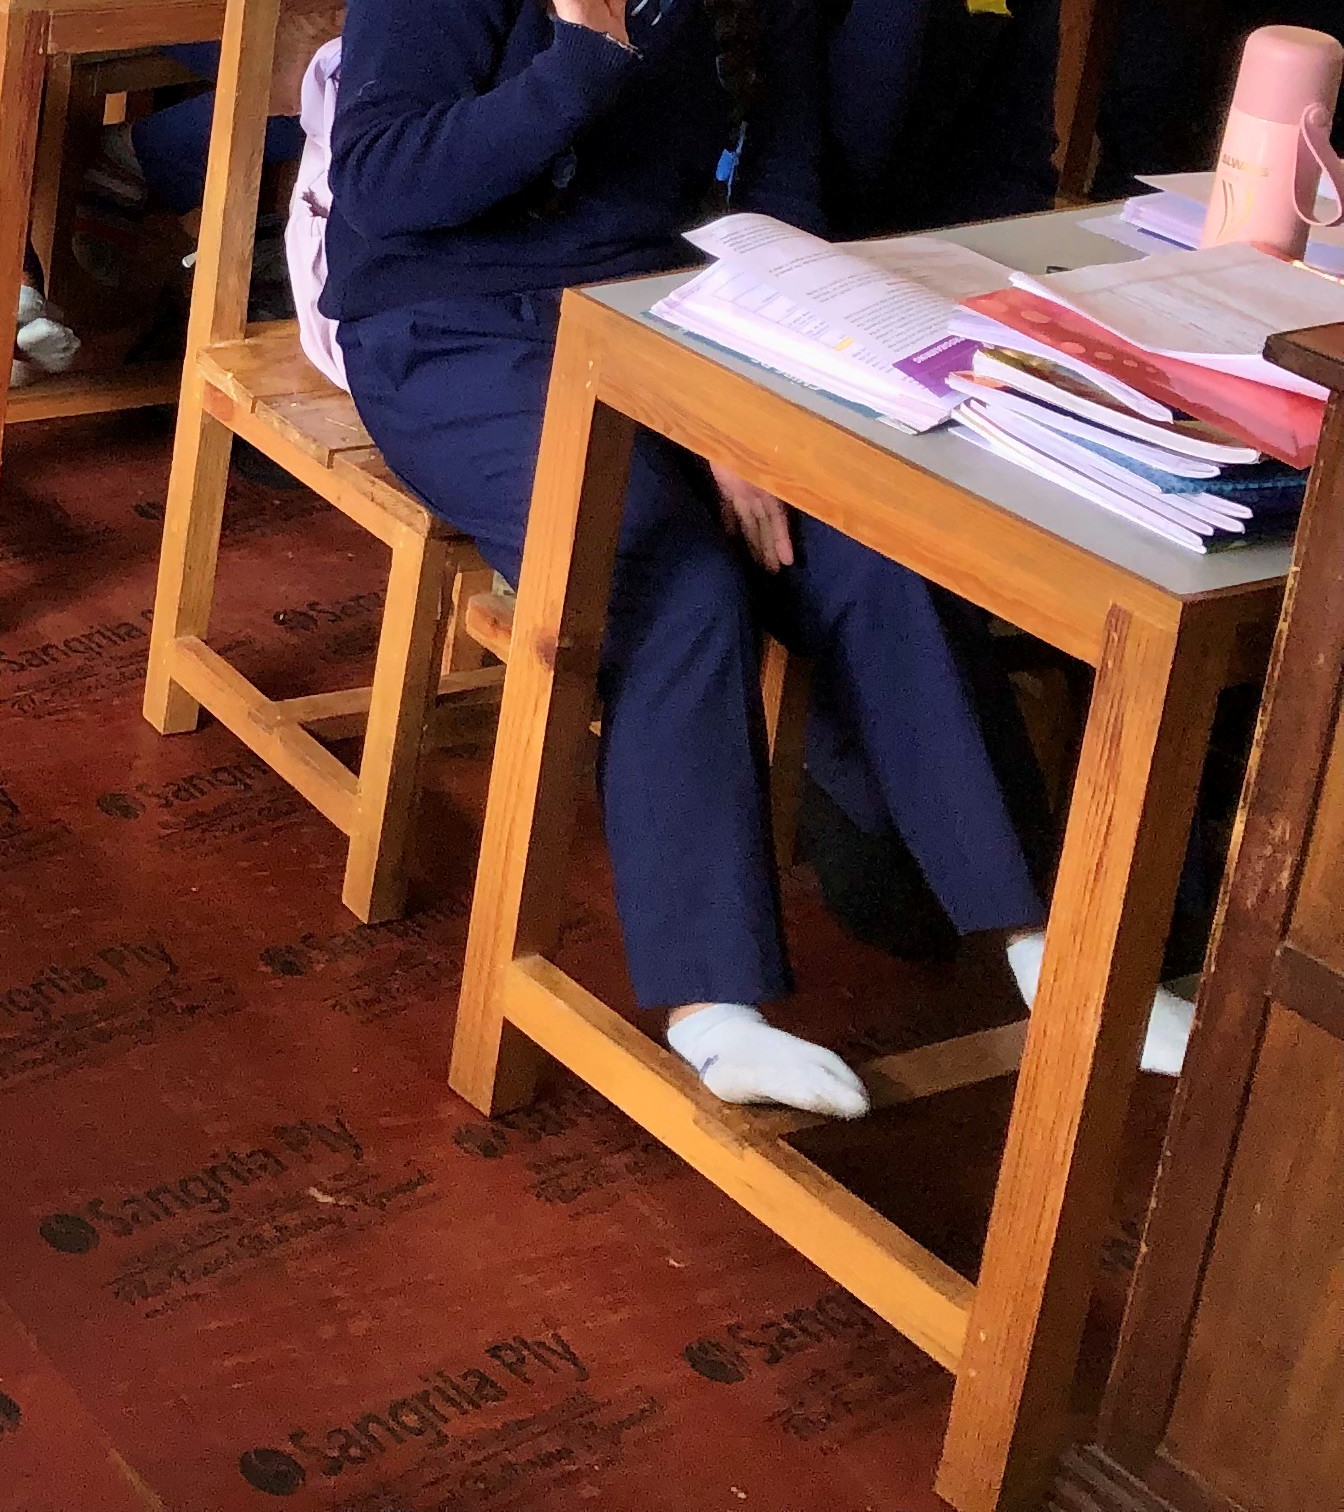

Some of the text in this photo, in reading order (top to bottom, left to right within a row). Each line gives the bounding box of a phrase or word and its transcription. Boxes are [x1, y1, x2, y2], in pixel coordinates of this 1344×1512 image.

[96, 941, 180, 977] Ply
[83, 1116, 364, 1238] Sangrila Ply
[288, 1367, 509, 1477] Sangrila
[484, 1332, 590, 1386] Ply
